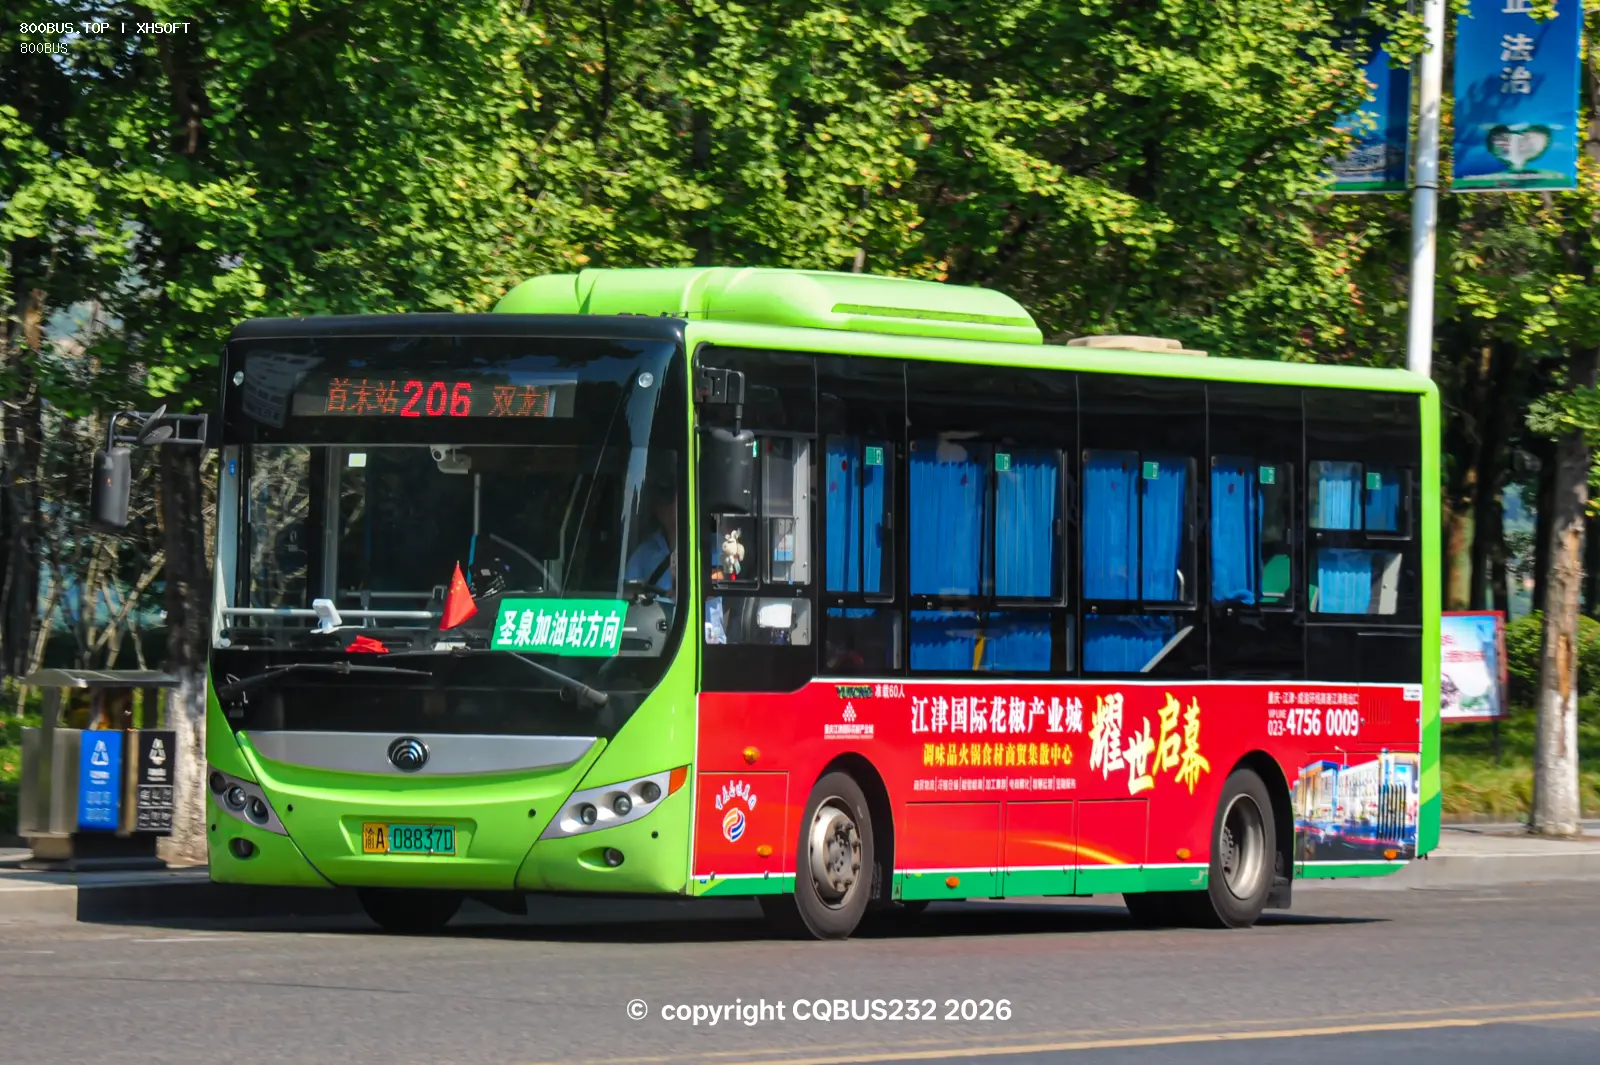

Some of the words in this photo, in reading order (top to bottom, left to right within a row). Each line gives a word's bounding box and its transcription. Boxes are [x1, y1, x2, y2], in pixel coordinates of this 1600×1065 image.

[1500, 33, 1534, 93] 法治
[327, 377, 399, 414] 首末站
[400, 380, 472, 417] 206
[497, 609, 620, 648] 圣泉加油站方向
[875, 684, 905, 698] 准载60人
[911, 696, 1083, 733] 江津国际花椒产业城
[1325, 708, 1359, 736] 0009
[1088, 692, 1210, 796] 耀世启幕
[365, 828, 384, 849] 渝A
[393, 828, 453, 850] 08837D
